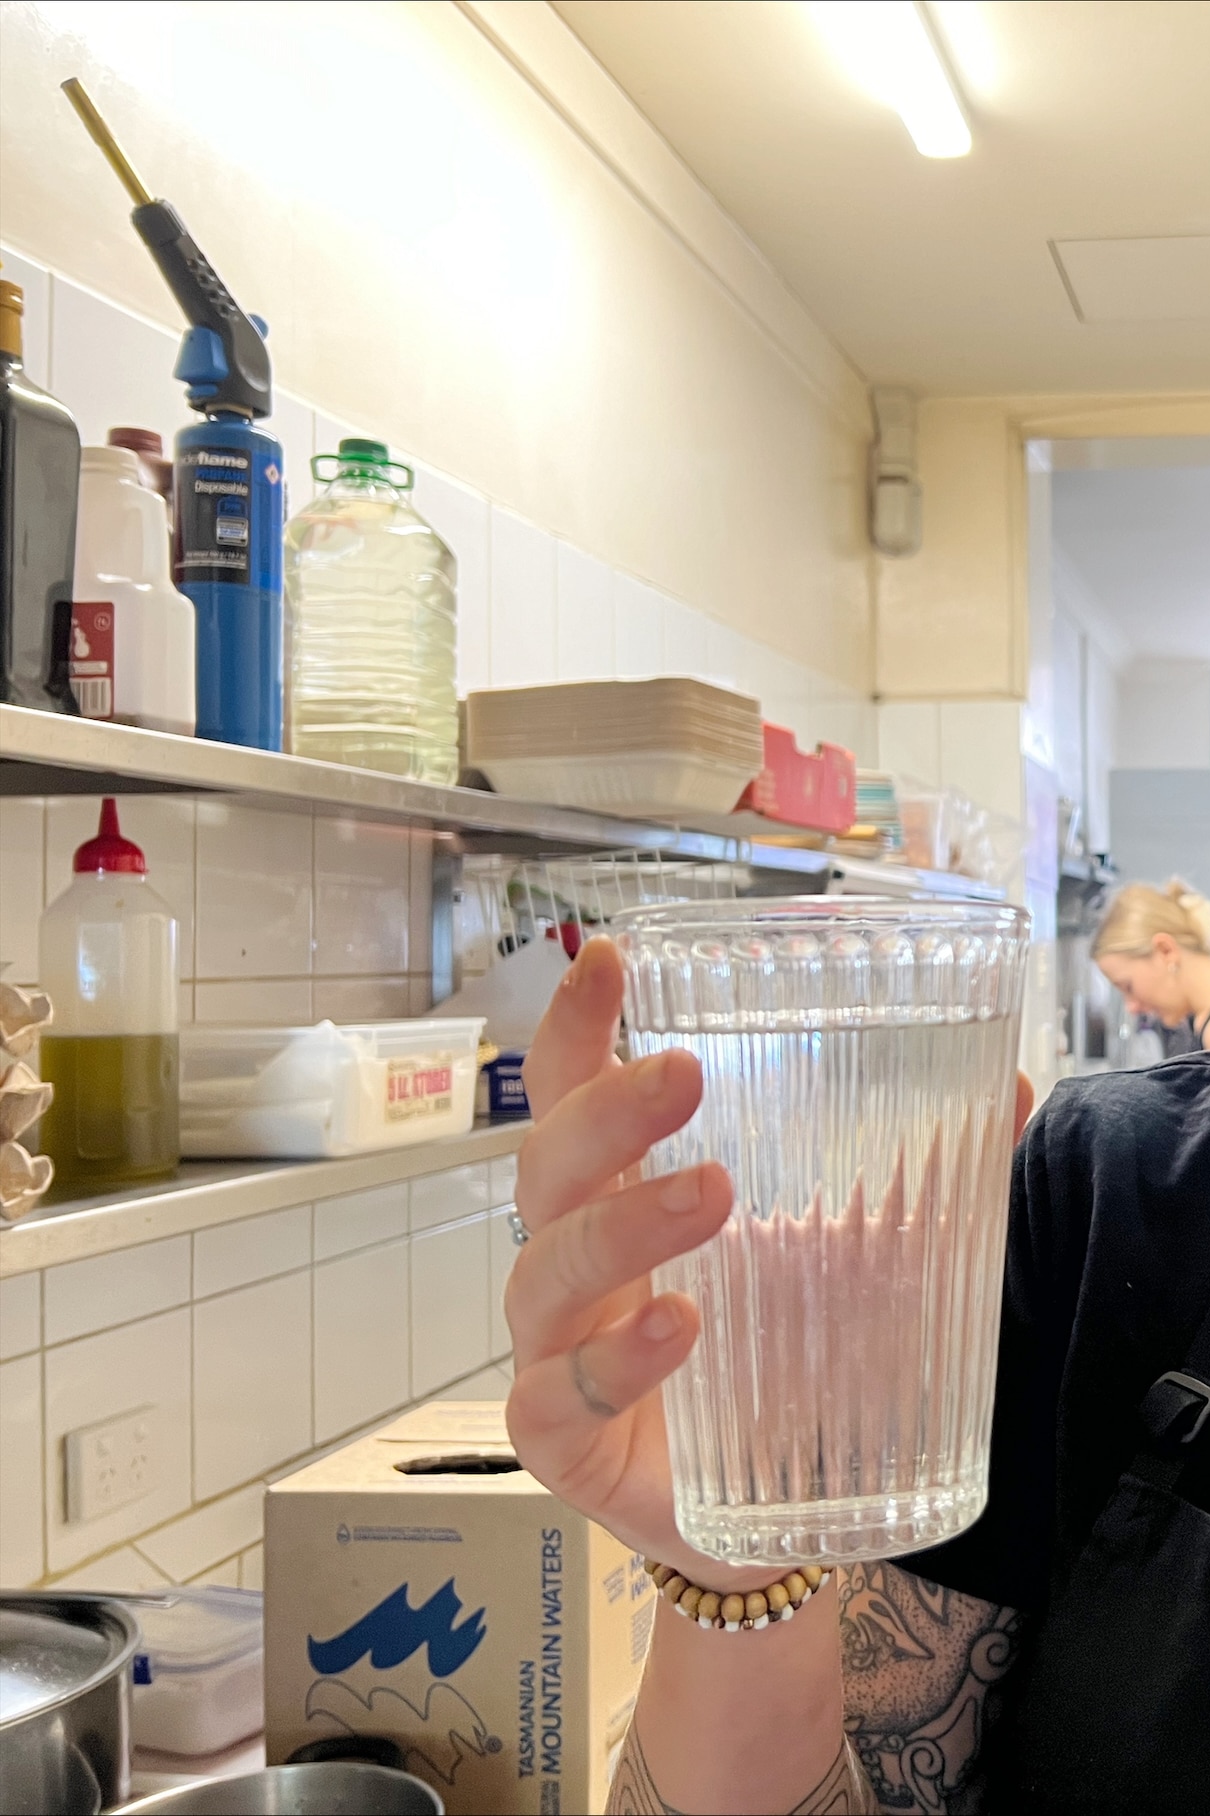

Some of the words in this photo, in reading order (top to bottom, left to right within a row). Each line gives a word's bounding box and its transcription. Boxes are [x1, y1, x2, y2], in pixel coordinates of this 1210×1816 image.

[194, 479, 249, 496] Disposable
[540, 1527, 563, 1627] WATERS
[518, 1659, 536, 1779] TASMANIAN
[540, 1633, 563, 1775] MOUNTAIN
